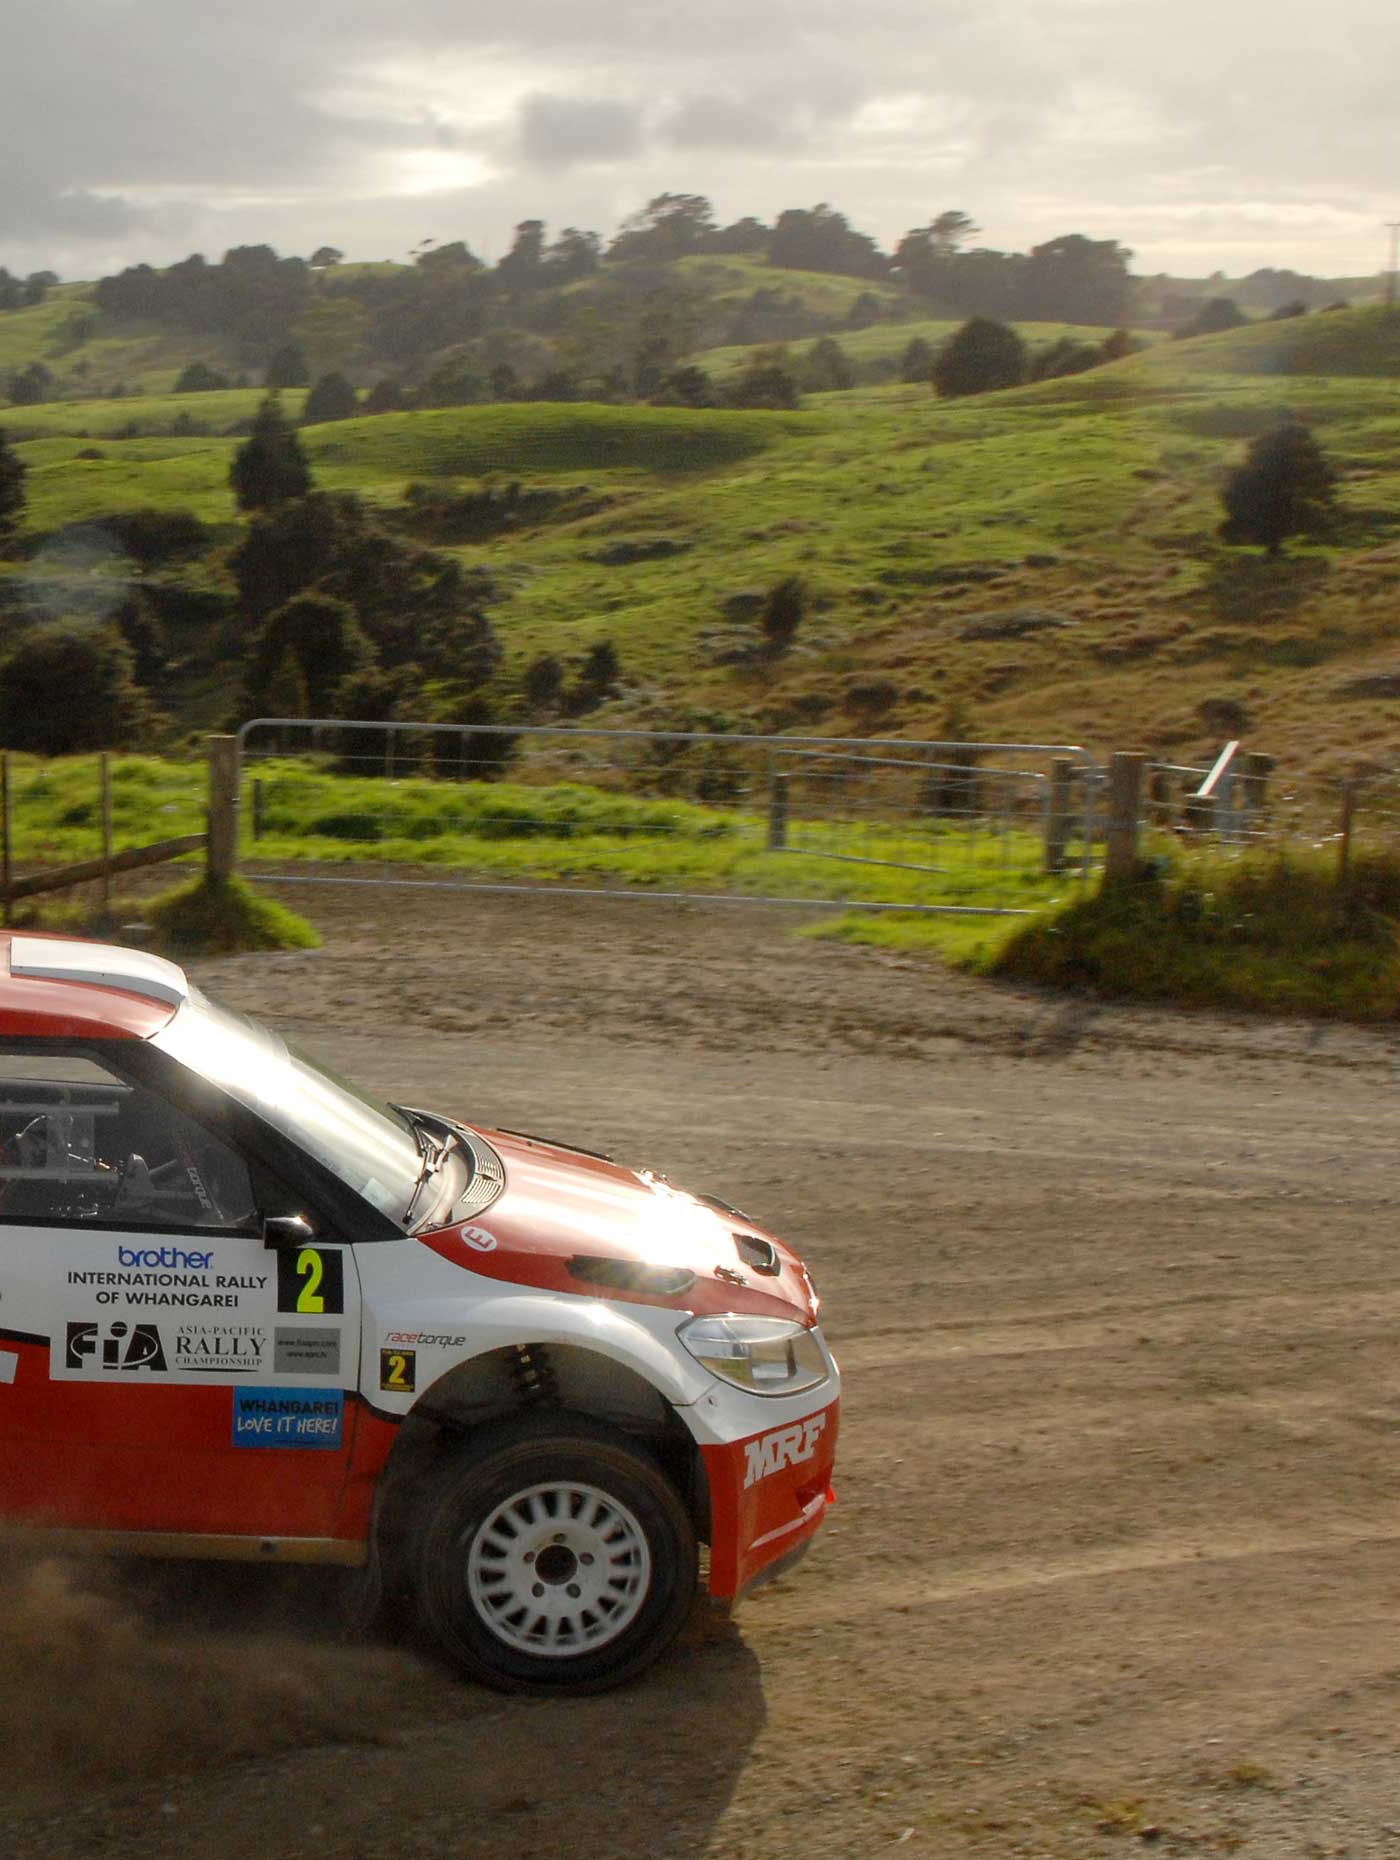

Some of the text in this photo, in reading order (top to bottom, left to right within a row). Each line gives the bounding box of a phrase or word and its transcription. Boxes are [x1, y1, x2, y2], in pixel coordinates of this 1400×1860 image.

[464, 1228, 494, 1249] E
[117, 1245, 214, 1269] brother
[67, 1271, 268, 1289] INTERNATIONAL RALLY
[296, 1248, 325, 1313] 2
[95, 1291, 239, 1307] OF WHANGAREI
[177, 1325, 265, 1336] ASIA-PACIFIC
[385, 1331, 467, 1349] racetorque
[175, 1336, 268, 1356] RALLY
[175, 1356, 263, 1367] CHAMPIONSHIP
[388, 1355, 406, 1384] 2
[239, 1399, 338, 1415] WHANGAREI
[277, 1415, 296, 1433] IT
[297, 1416, 338, 1434] HERE!
[743, 1412, 827, 1490] MRF
